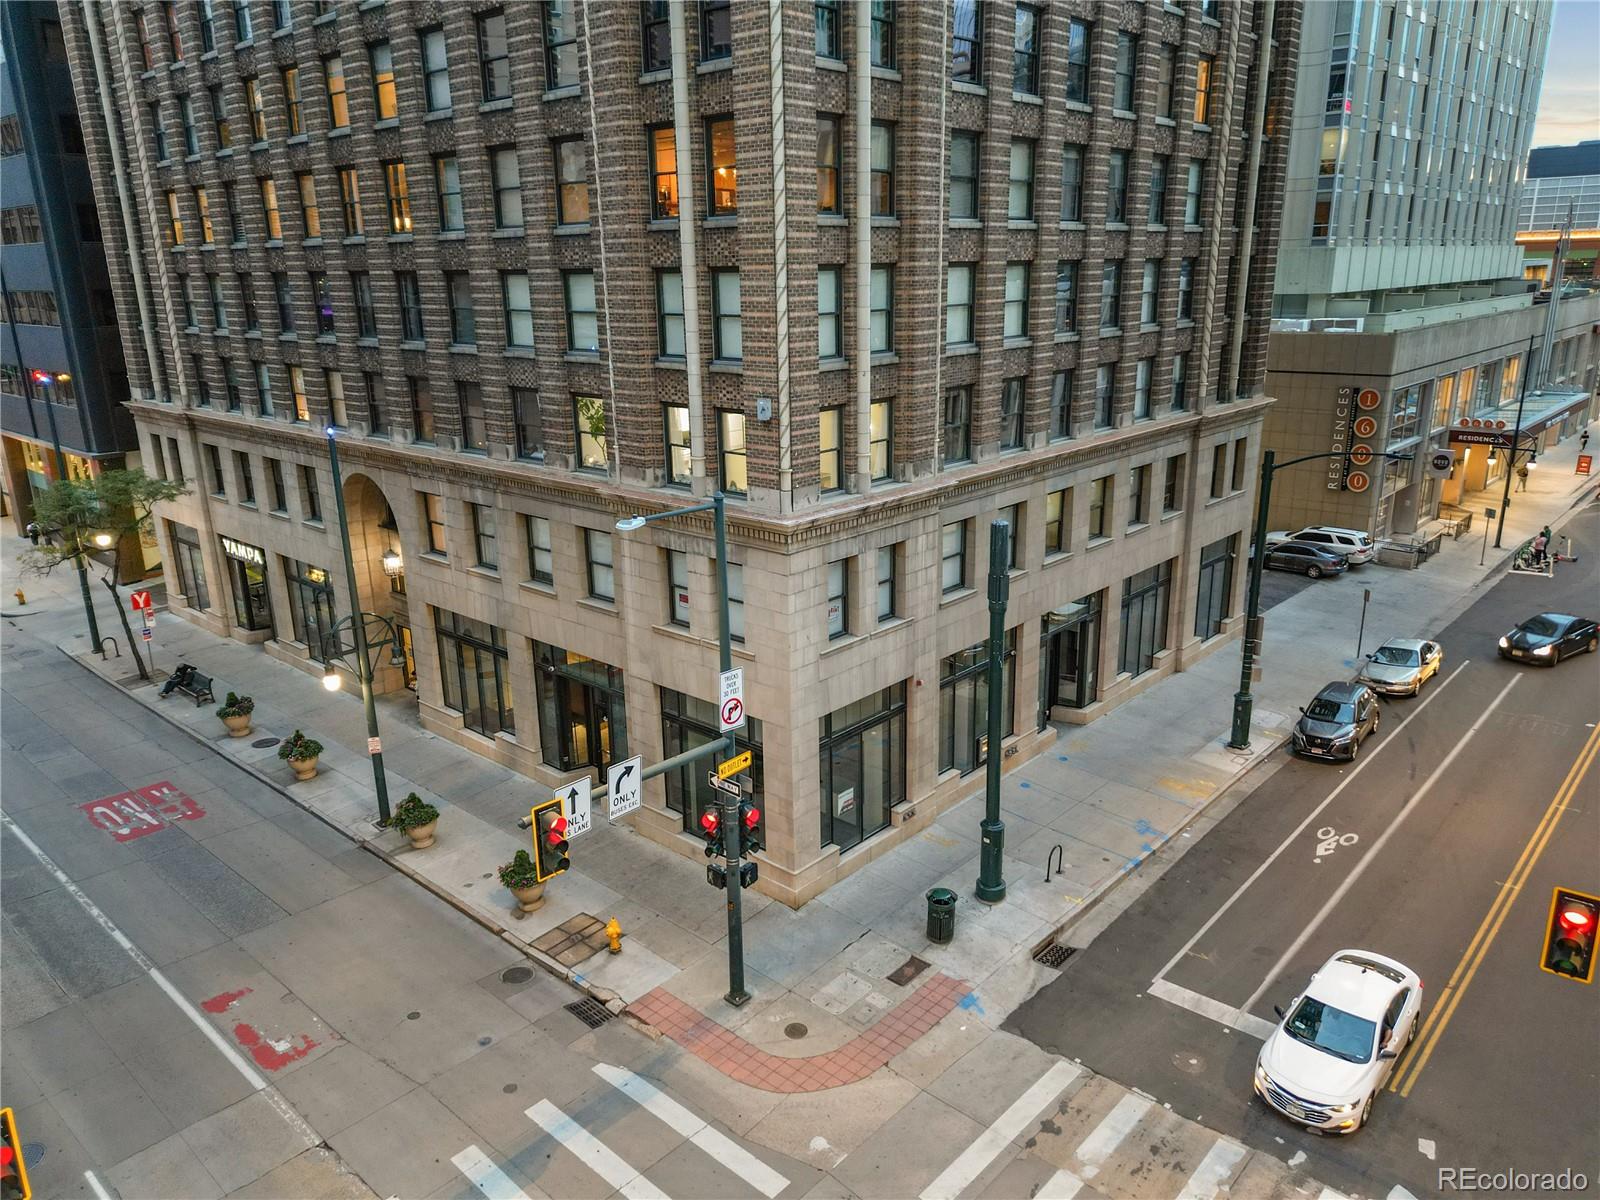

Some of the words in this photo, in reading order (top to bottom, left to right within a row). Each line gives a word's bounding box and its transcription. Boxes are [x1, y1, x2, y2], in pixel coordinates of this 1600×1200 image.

[1328, 387, 1350, 490] RESIDENCES
[222, 538, 263, 565] YAMPA
[724, 673, 739, 682] TRUCKS
[726, 681, 737, 689] OVER
[730, 687, 740, 695] FEET
[727, 784, 738, 793] WAY
[613, 789, 637, 807] ONLY
[610, 804, 627, 816] BUSES
[567, 812, 586, 827] NLY
[574, 822, 590, 834] LANE
